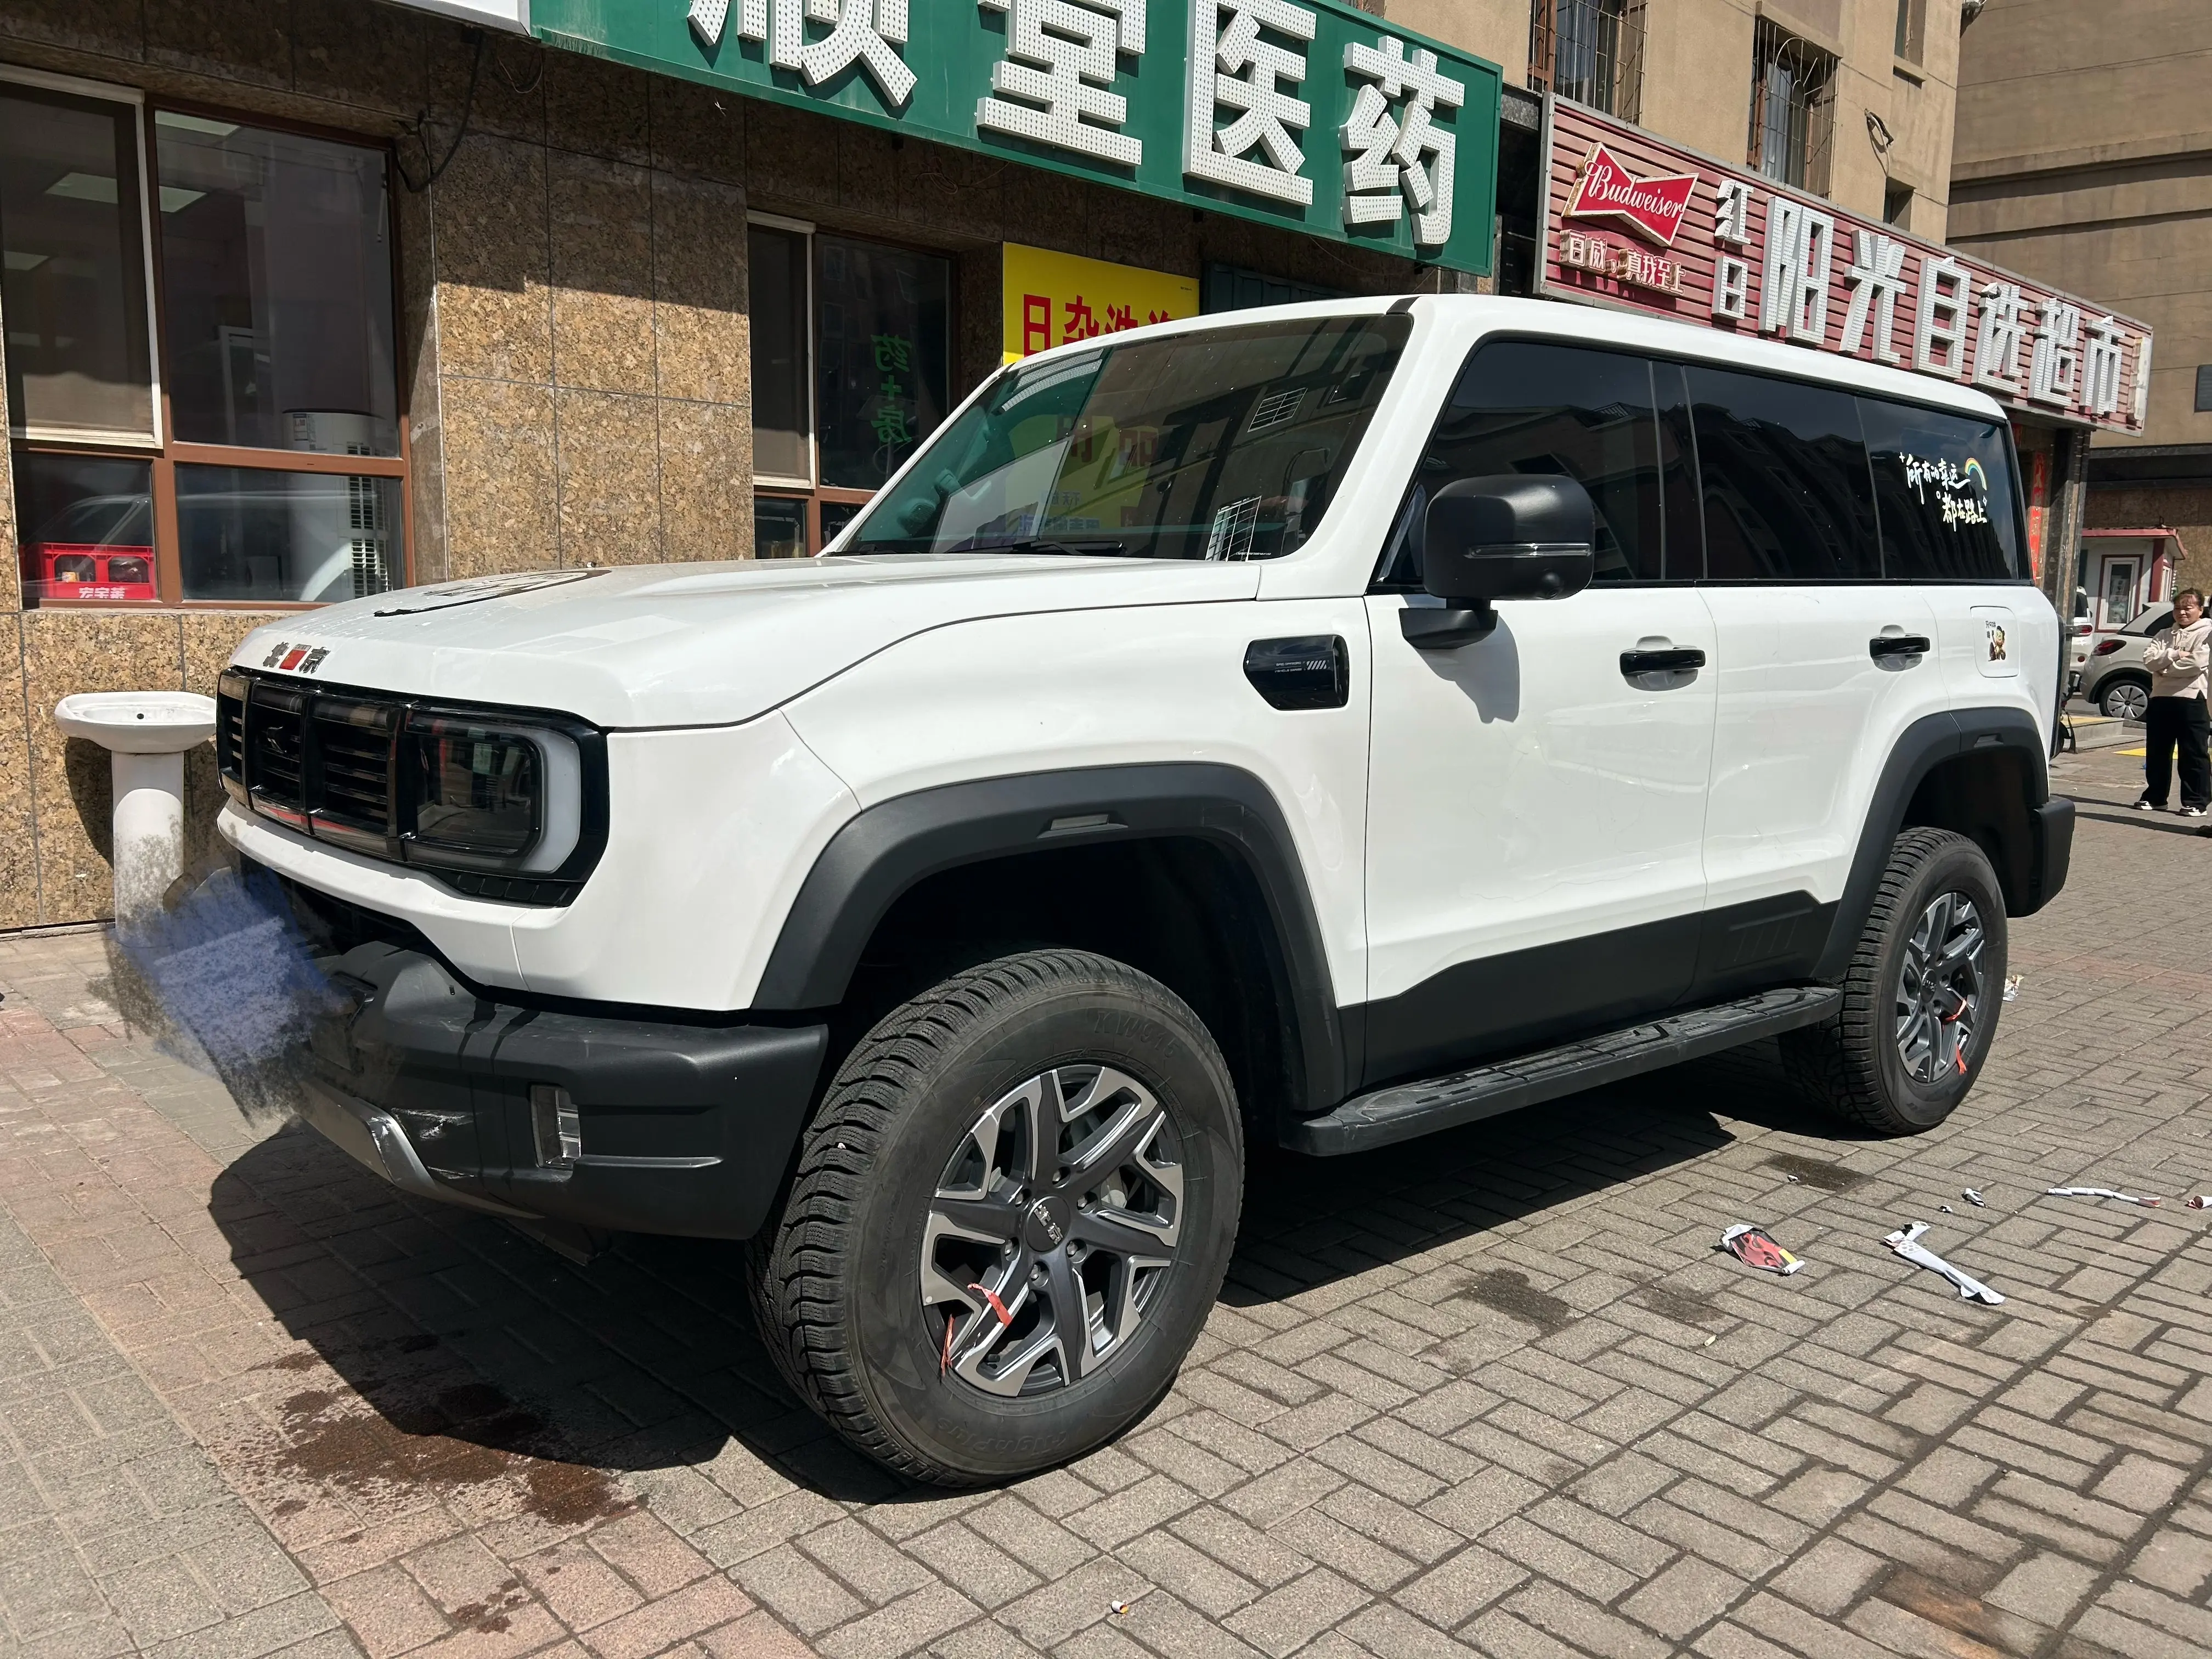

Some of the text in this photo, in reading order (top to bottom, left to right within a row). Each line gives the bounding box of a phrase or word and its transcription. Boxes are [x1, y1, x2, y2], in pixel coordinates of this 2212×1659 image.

[1584, 160, 1686, 219] Budweiser
[1024, 294, 1174, 358] 日杂
[1758, 195, 2125, 416] 阳光自选超市
[1906, 453, 1971, 505] 所有的幸运
[1942, 492, 1987, 532] 都在路上
